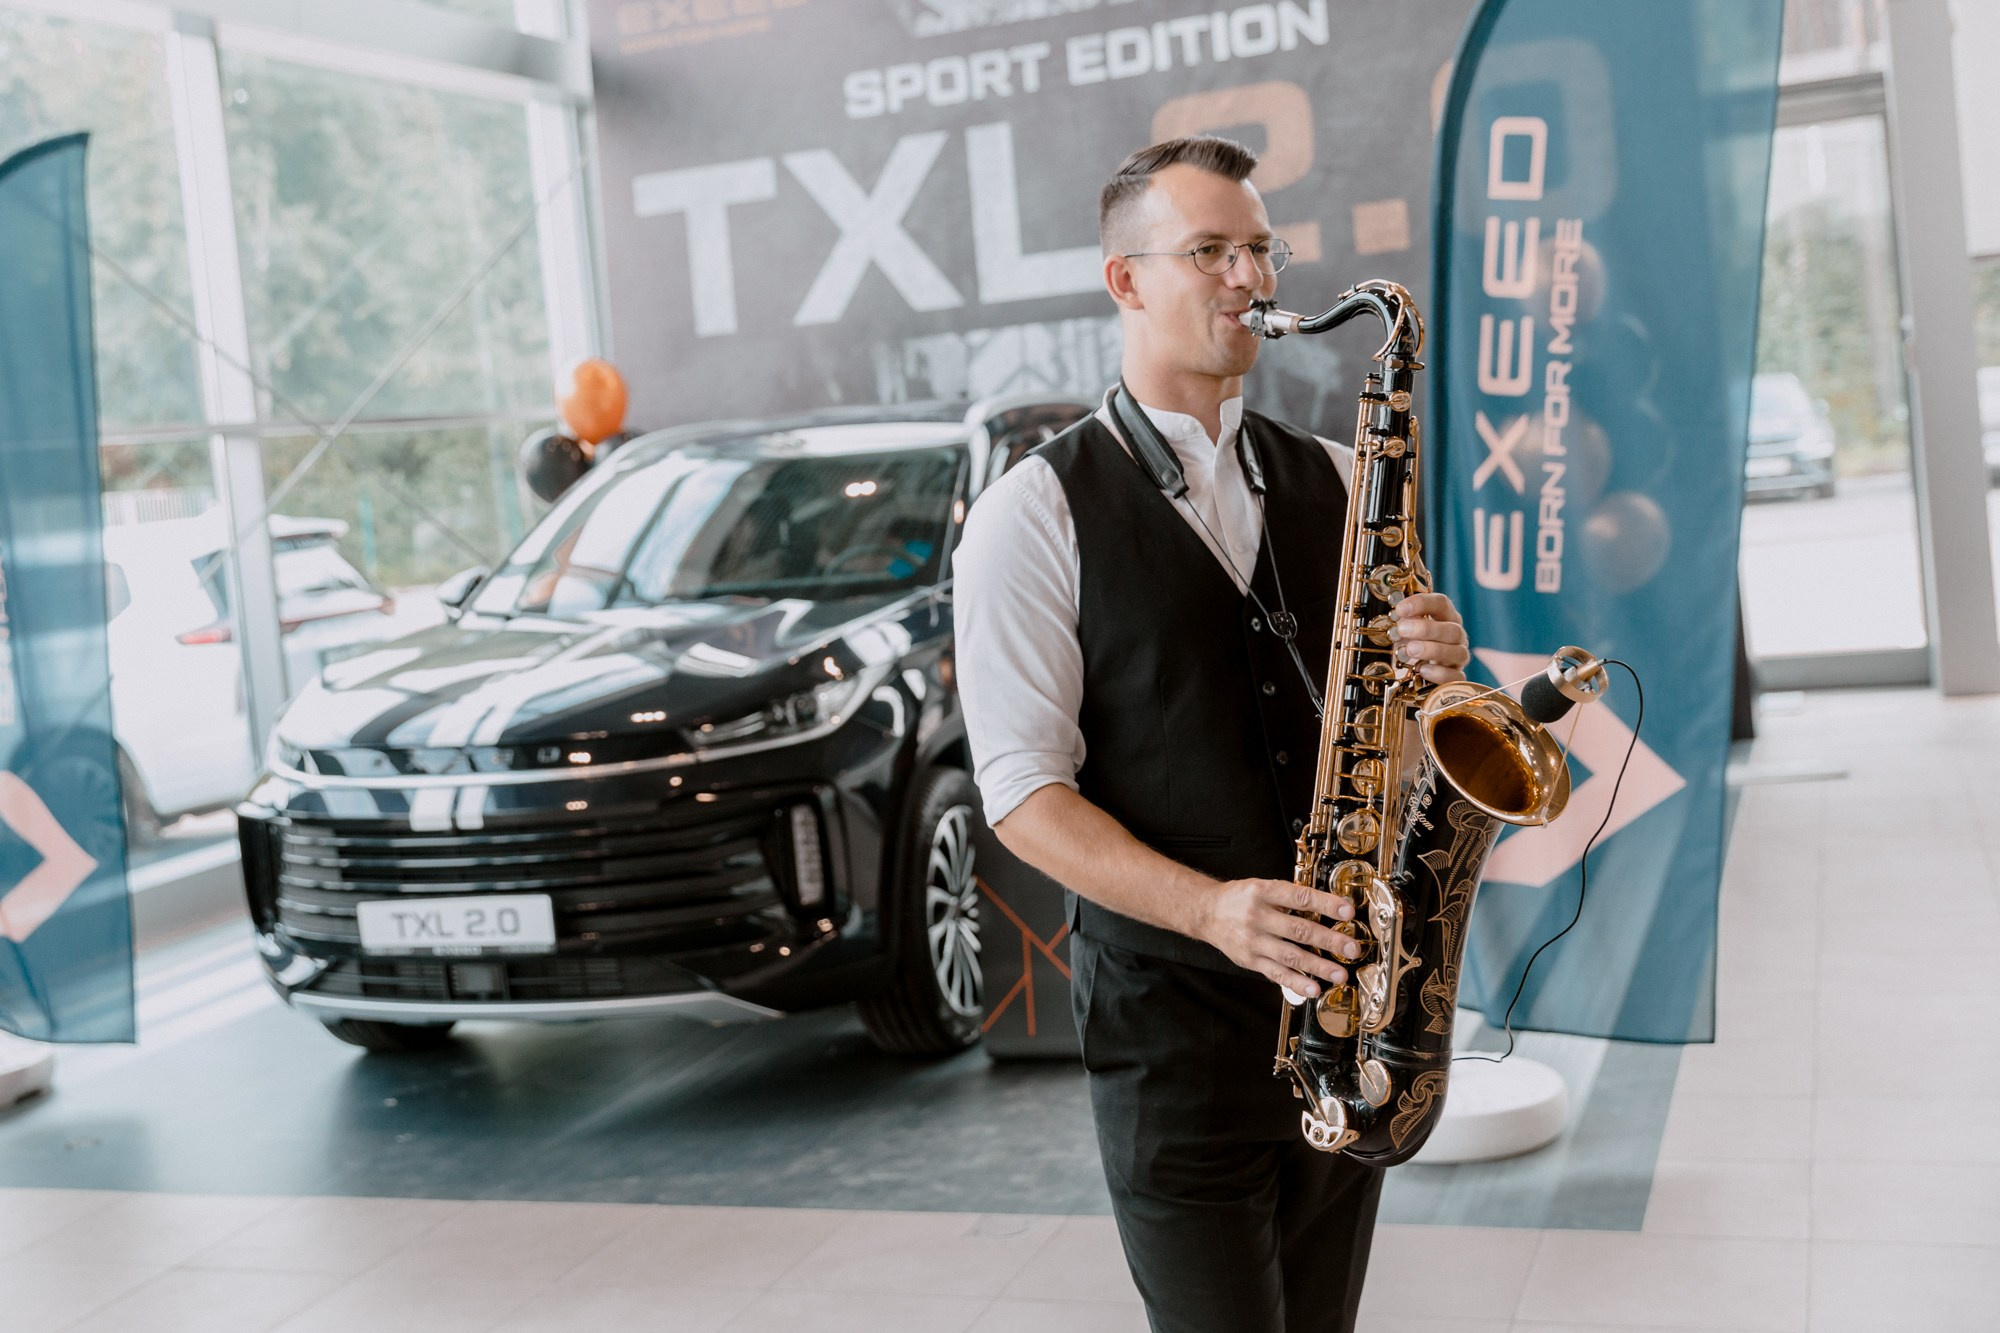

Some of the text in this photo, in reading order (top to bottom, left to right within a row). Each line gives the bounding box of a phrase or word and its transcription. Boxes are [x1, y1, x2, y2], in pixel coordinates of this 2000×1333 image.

[842, 40, 1050, 120] SPORT
[1065, 0, 1330, 86] EDITION
[632, 121, 1107, 338] TXL
[1473, 115, 1548, 593] EXEED
[1534, 217, 1584, 594] BORN FOR MORE
[1408, 792, 1435, 831] Custom
[391, 906, 521, 938] TXL 2.0
